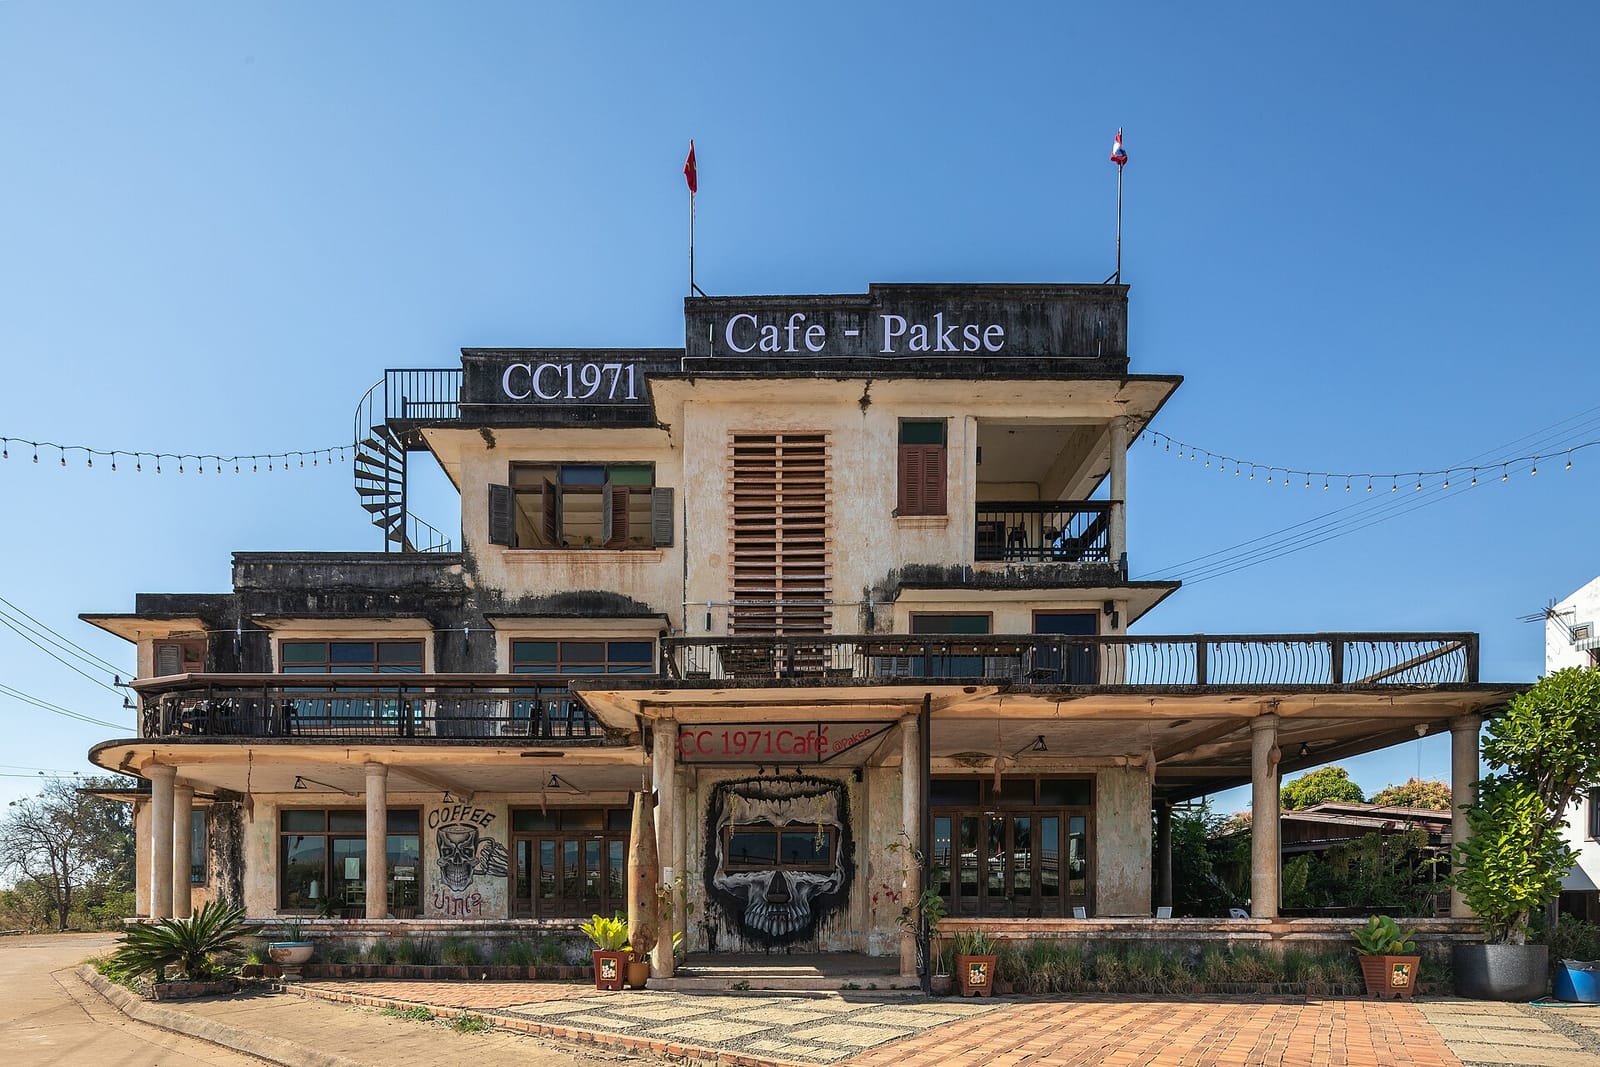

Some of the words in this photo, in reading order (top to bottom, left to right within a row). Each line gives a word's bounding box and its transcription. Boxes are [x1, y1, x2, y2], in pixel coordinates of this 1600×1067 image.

[725, 312, 826, 353] Cafe
[879, 312, 1005, 353] Pakse
[502, 363, 639, 400] CC1971
[678, 730, 714, 756] CC
[428, 805, 497, 829] COFFEE
